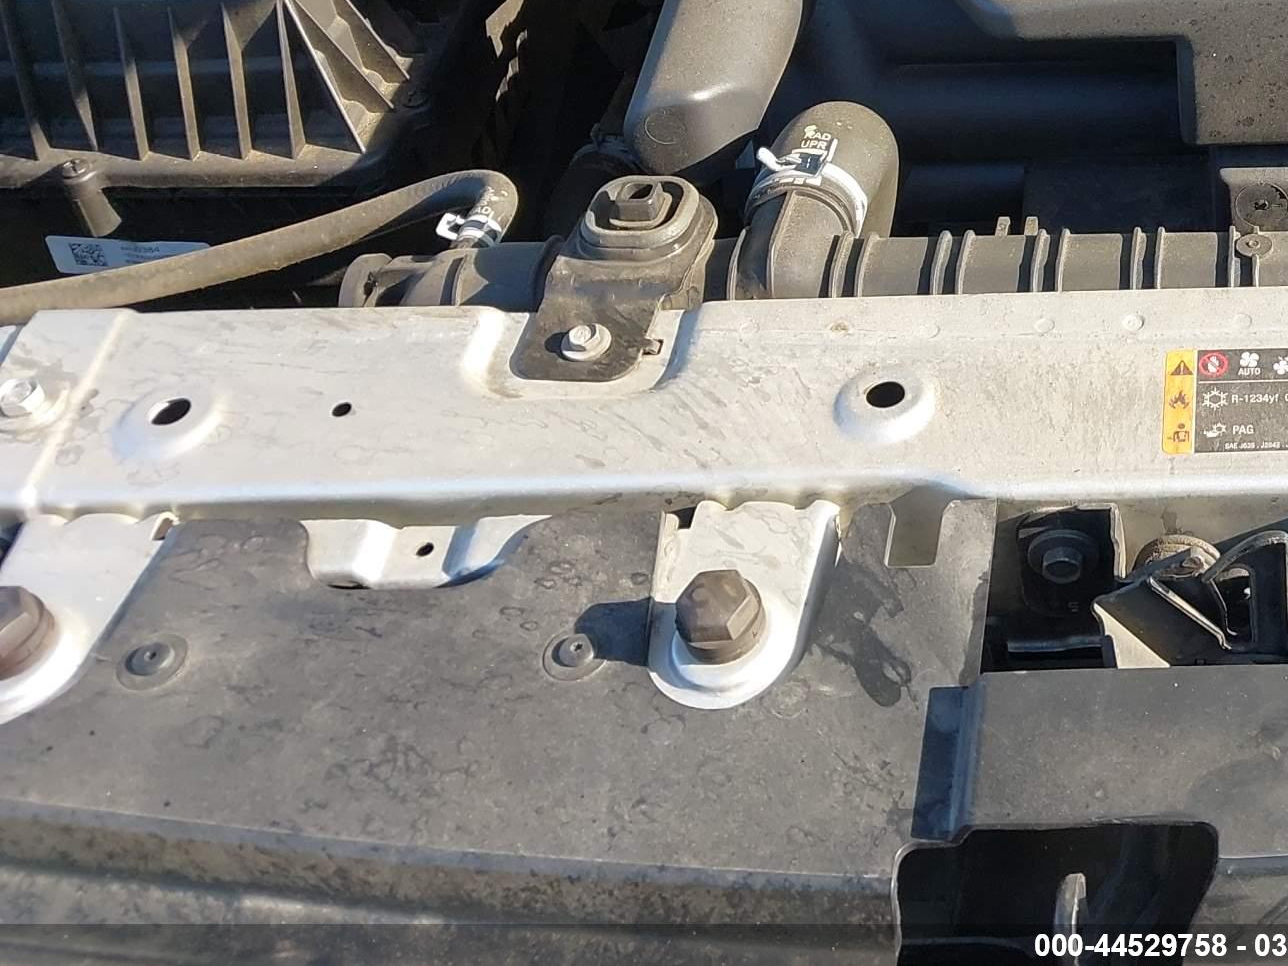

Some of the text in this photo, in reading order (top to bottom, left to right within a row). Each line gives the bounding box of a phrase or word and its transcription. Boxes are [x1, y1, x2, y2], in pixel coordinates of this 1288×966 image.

[804, 131, 832, 141] RAD
[800, 139, 828, 149] UPR
[1237, 367, 1261, 376] AUTO
[1231, 393, 1279, 404] R-1234yf
[1232, 424, 1255, 435] PAG
